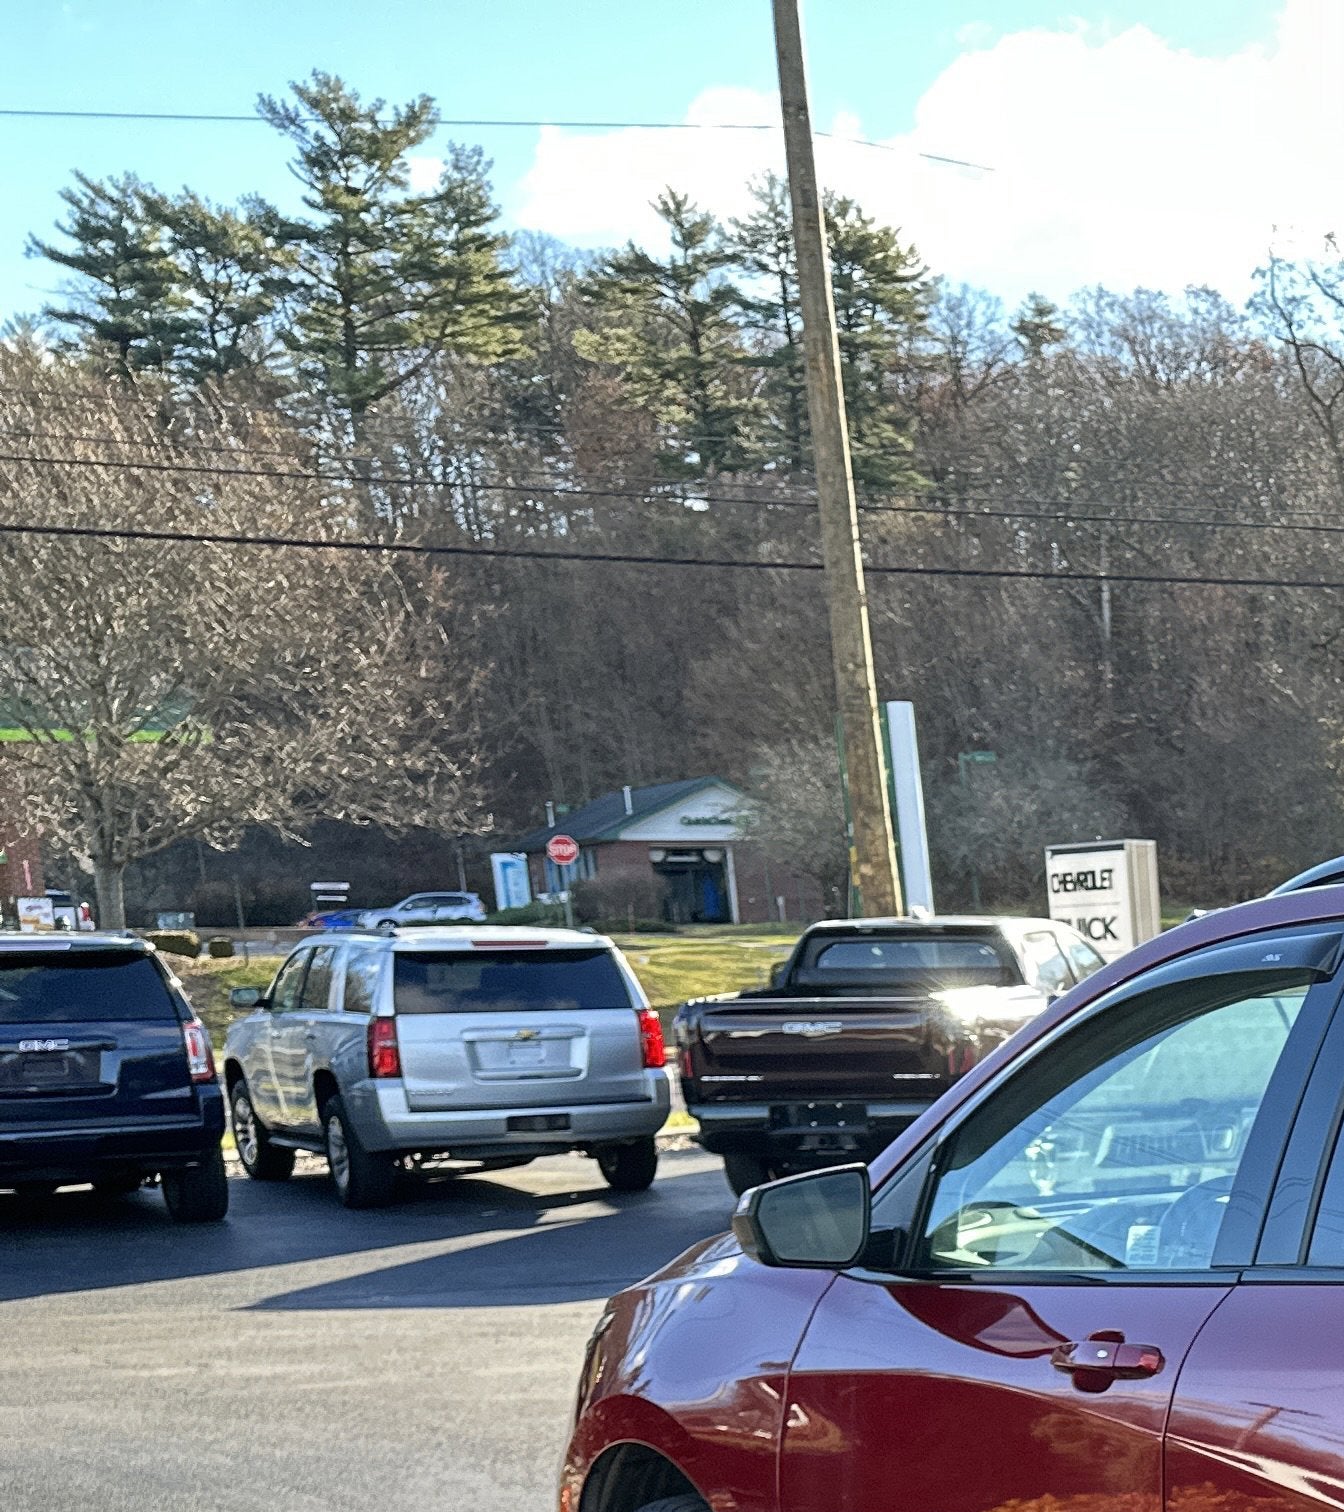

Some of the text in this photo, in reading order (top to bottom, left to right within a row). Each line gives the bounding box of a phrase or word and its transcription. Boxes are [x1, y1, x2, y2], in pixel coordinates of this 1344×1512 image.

[549, 843, 577, 857] STOP
[1051, 868, 1113, 893] CHEVROLET
[782, 1022, 842, 1034] GMC
[19, 1039, 69, 1052] GMC
